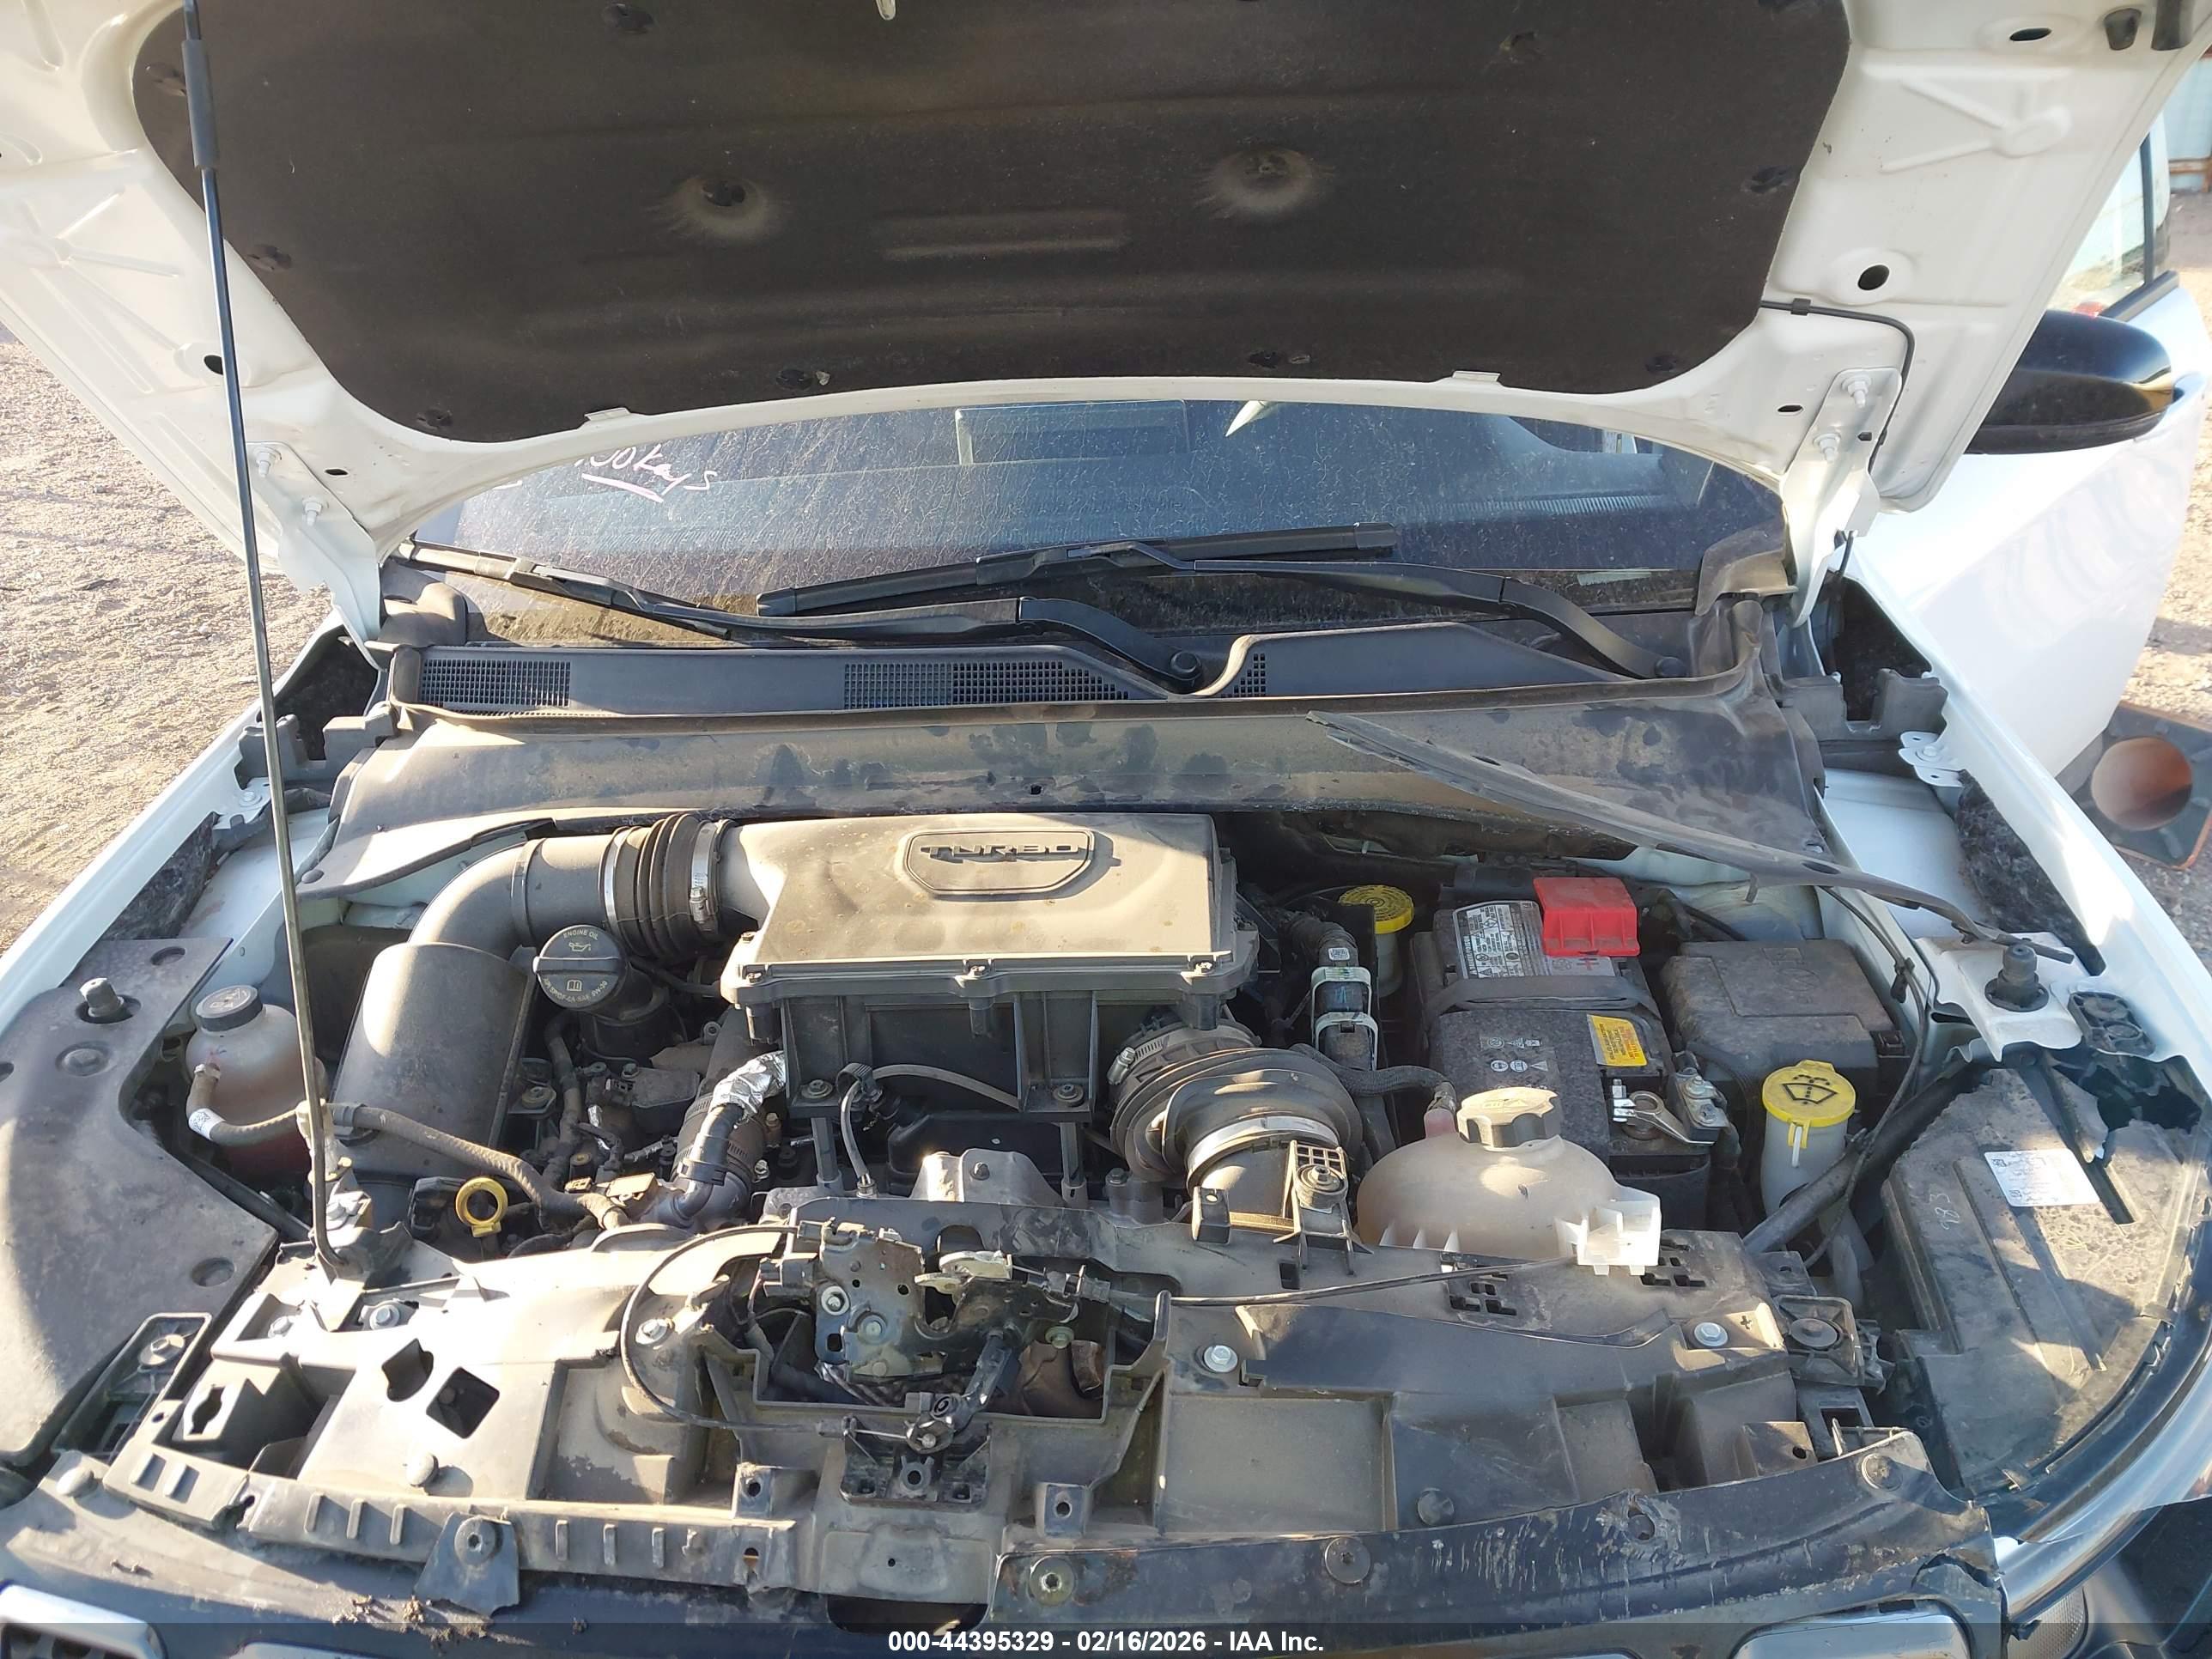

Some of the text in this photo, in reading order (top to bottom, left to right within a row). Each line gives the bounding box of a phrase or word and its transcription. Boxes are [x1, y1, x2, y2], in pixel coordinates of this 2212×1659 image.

[919, 843, 1080, 859] TURBO
[562, 929, 599, 940] ENGINE OIL
